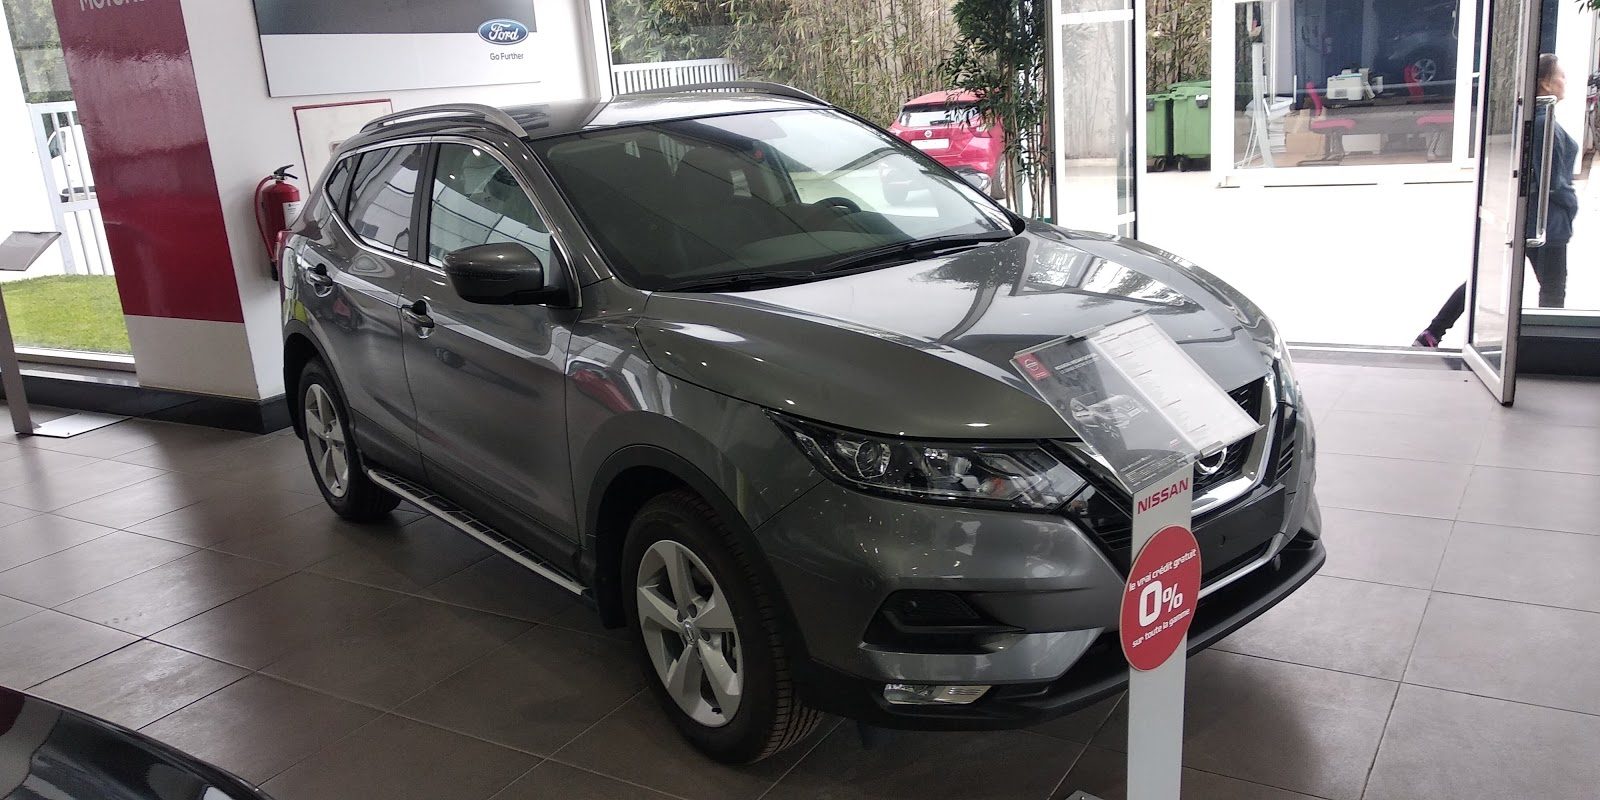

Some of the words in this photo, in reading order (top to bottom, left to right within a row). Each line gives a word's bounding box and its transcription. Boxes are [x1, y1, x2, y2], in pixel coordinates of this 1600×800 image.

[489, 23, 519, 40] Ford
[501, 52, 523, 60] Further
[1137, 477, 1188, 514] NISSAN
[1129, 582, 1136, 592] le
[1137, 572, 1151, 587] vrai
[1152, 561, 1172, 578] crédit
[1173, 548, 1196, 569] gratuit
[1139, 580, 1183, 627] 0%
[1132, 636, 1144, 648] sur
[1145, 625, 1162, 641] toute
[1163, 621, 1169, 630] la
[1169, 608, 1190, 627] gamme
